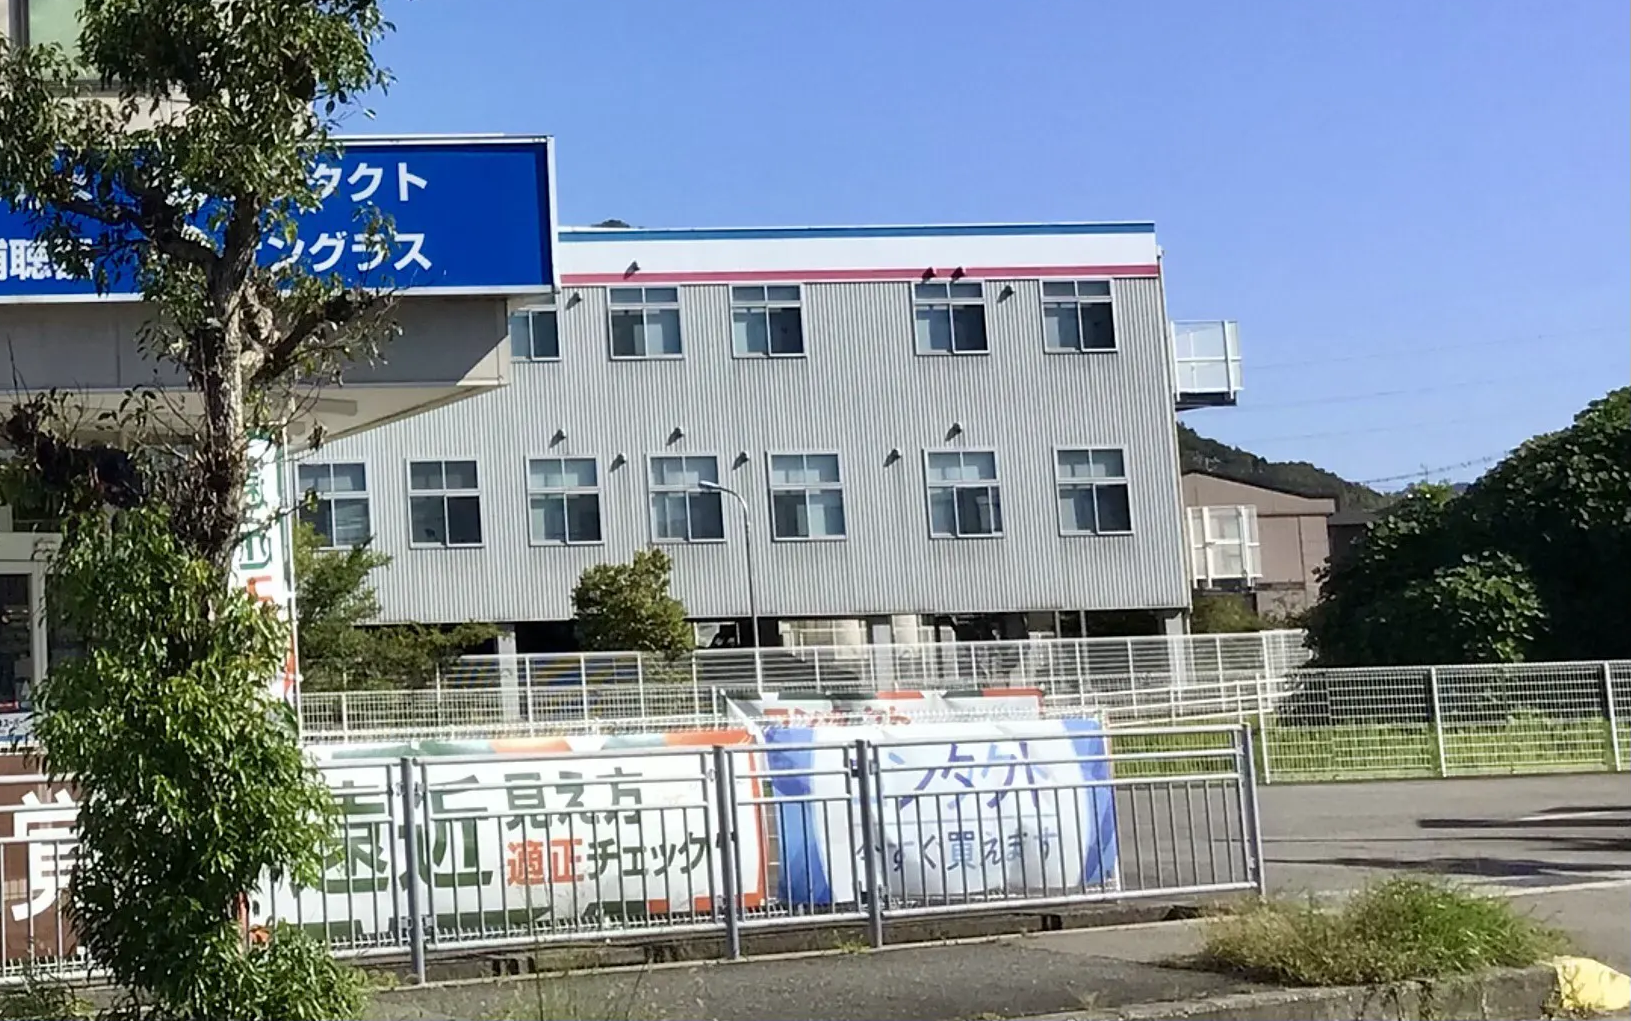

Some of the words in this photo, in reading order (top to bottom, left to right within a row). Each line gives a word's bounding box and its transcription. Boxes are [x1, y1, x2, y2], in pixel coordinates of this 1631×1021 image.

[254, 230, 433, 273] ングラス
[503, 766, 644, 831] 見え方
[506, 830, 738, 886] 適正チェック
